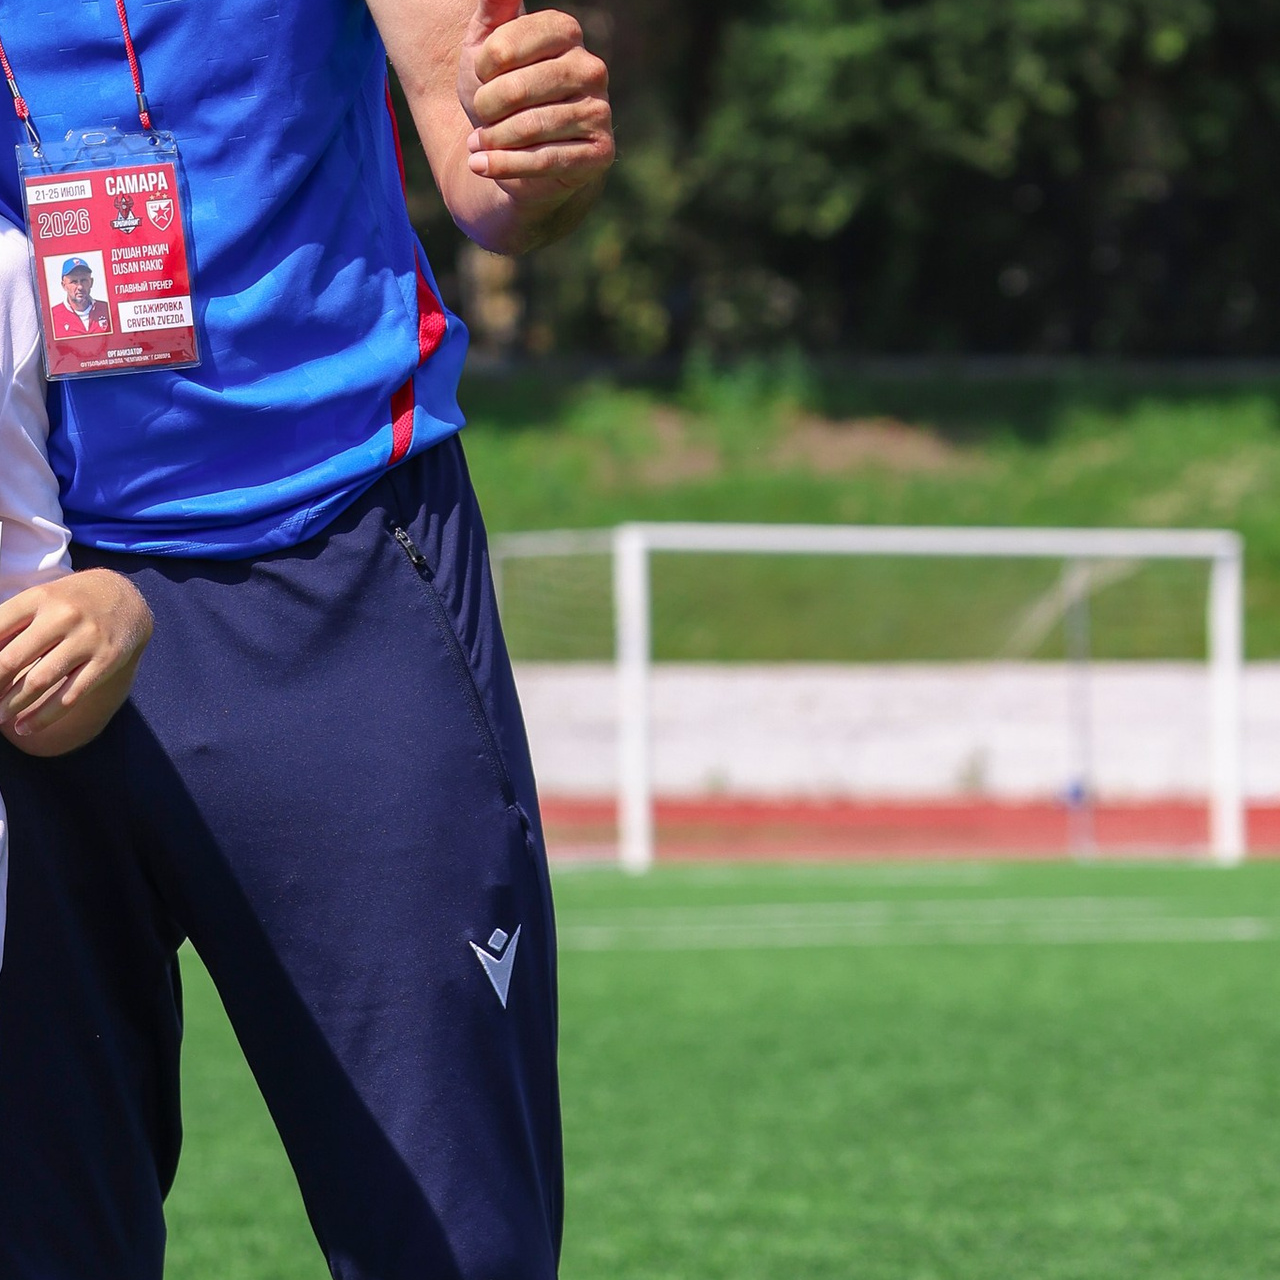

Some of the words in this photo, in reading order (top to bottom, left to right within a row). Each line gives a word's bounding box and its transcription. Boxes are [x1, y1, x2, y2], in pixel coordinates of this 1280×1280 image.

[104, 170, 168, 196] САМАРА
[35, 188, 59, 200] 21-25
[60, 184, 85, 197] ИЮЛЯ
[37, 207, 91, 238] 2026
[110, 246, 141, 261] ДУШАН
[141, 243, 169, 256] РАКИЧ
[112, 261, 138, 275] DUSAN
[139, 258, 163, 272] RAKIC
[148, 279, 174, 290] ТРЕНЕР
[133, 300, 183, 314] СТАЖИРОВКА
[126, 316, 156, 328] CRVENA
[156, 313, 184, 325] ZVEZDA
